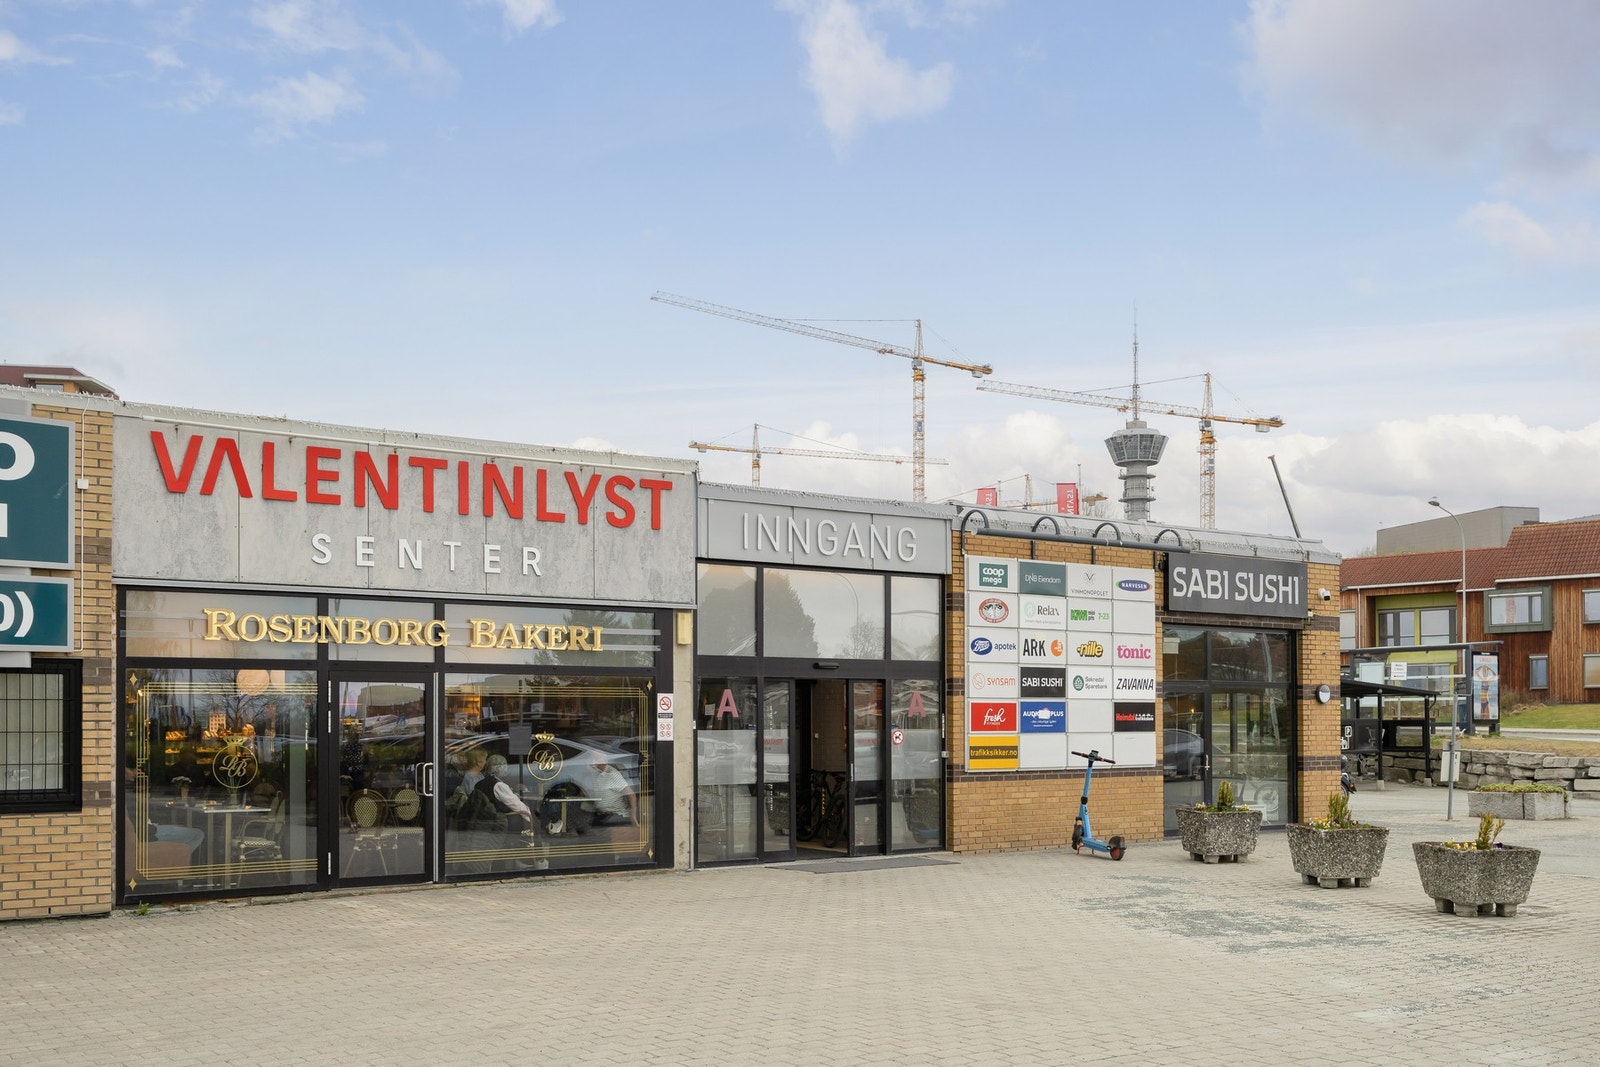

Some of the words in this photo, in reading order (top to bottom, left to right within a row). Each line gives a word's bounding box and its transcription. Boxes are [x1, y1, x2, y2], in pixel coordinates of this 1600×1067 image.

[150, 430, 673, 530] VALENTINLYST
[743, 512, 917, 562] INNGANG
[311, 533, 542, 577] SENTER
[983, 567, 1005, 577] coop
[983, 577, 1002, 585] mega
[1071, 588, 1108, 597] VINMONOPOLET
[1173, 566, 1229, 600] SABI
[1234, 571, 1299, 605] SUSHI
[469, 618, 603, 651] BAKERI
[994, 642, 1017, 651] apotek
[1023, 638, 1046, 657] ARK
[1079, 640, 1103, 657] nille
[1117, 644, 1151, 659] tonic
[1022, 677, 1040, 687] SABI
[1041, 677, 1063, 687] SUSHI
[1116, 678, 1154, 691] ZAVANNA
[716, 688, 739, 720] A
[908, 691, 926, 717] A
[983, 707, 1006, 726] fresh
